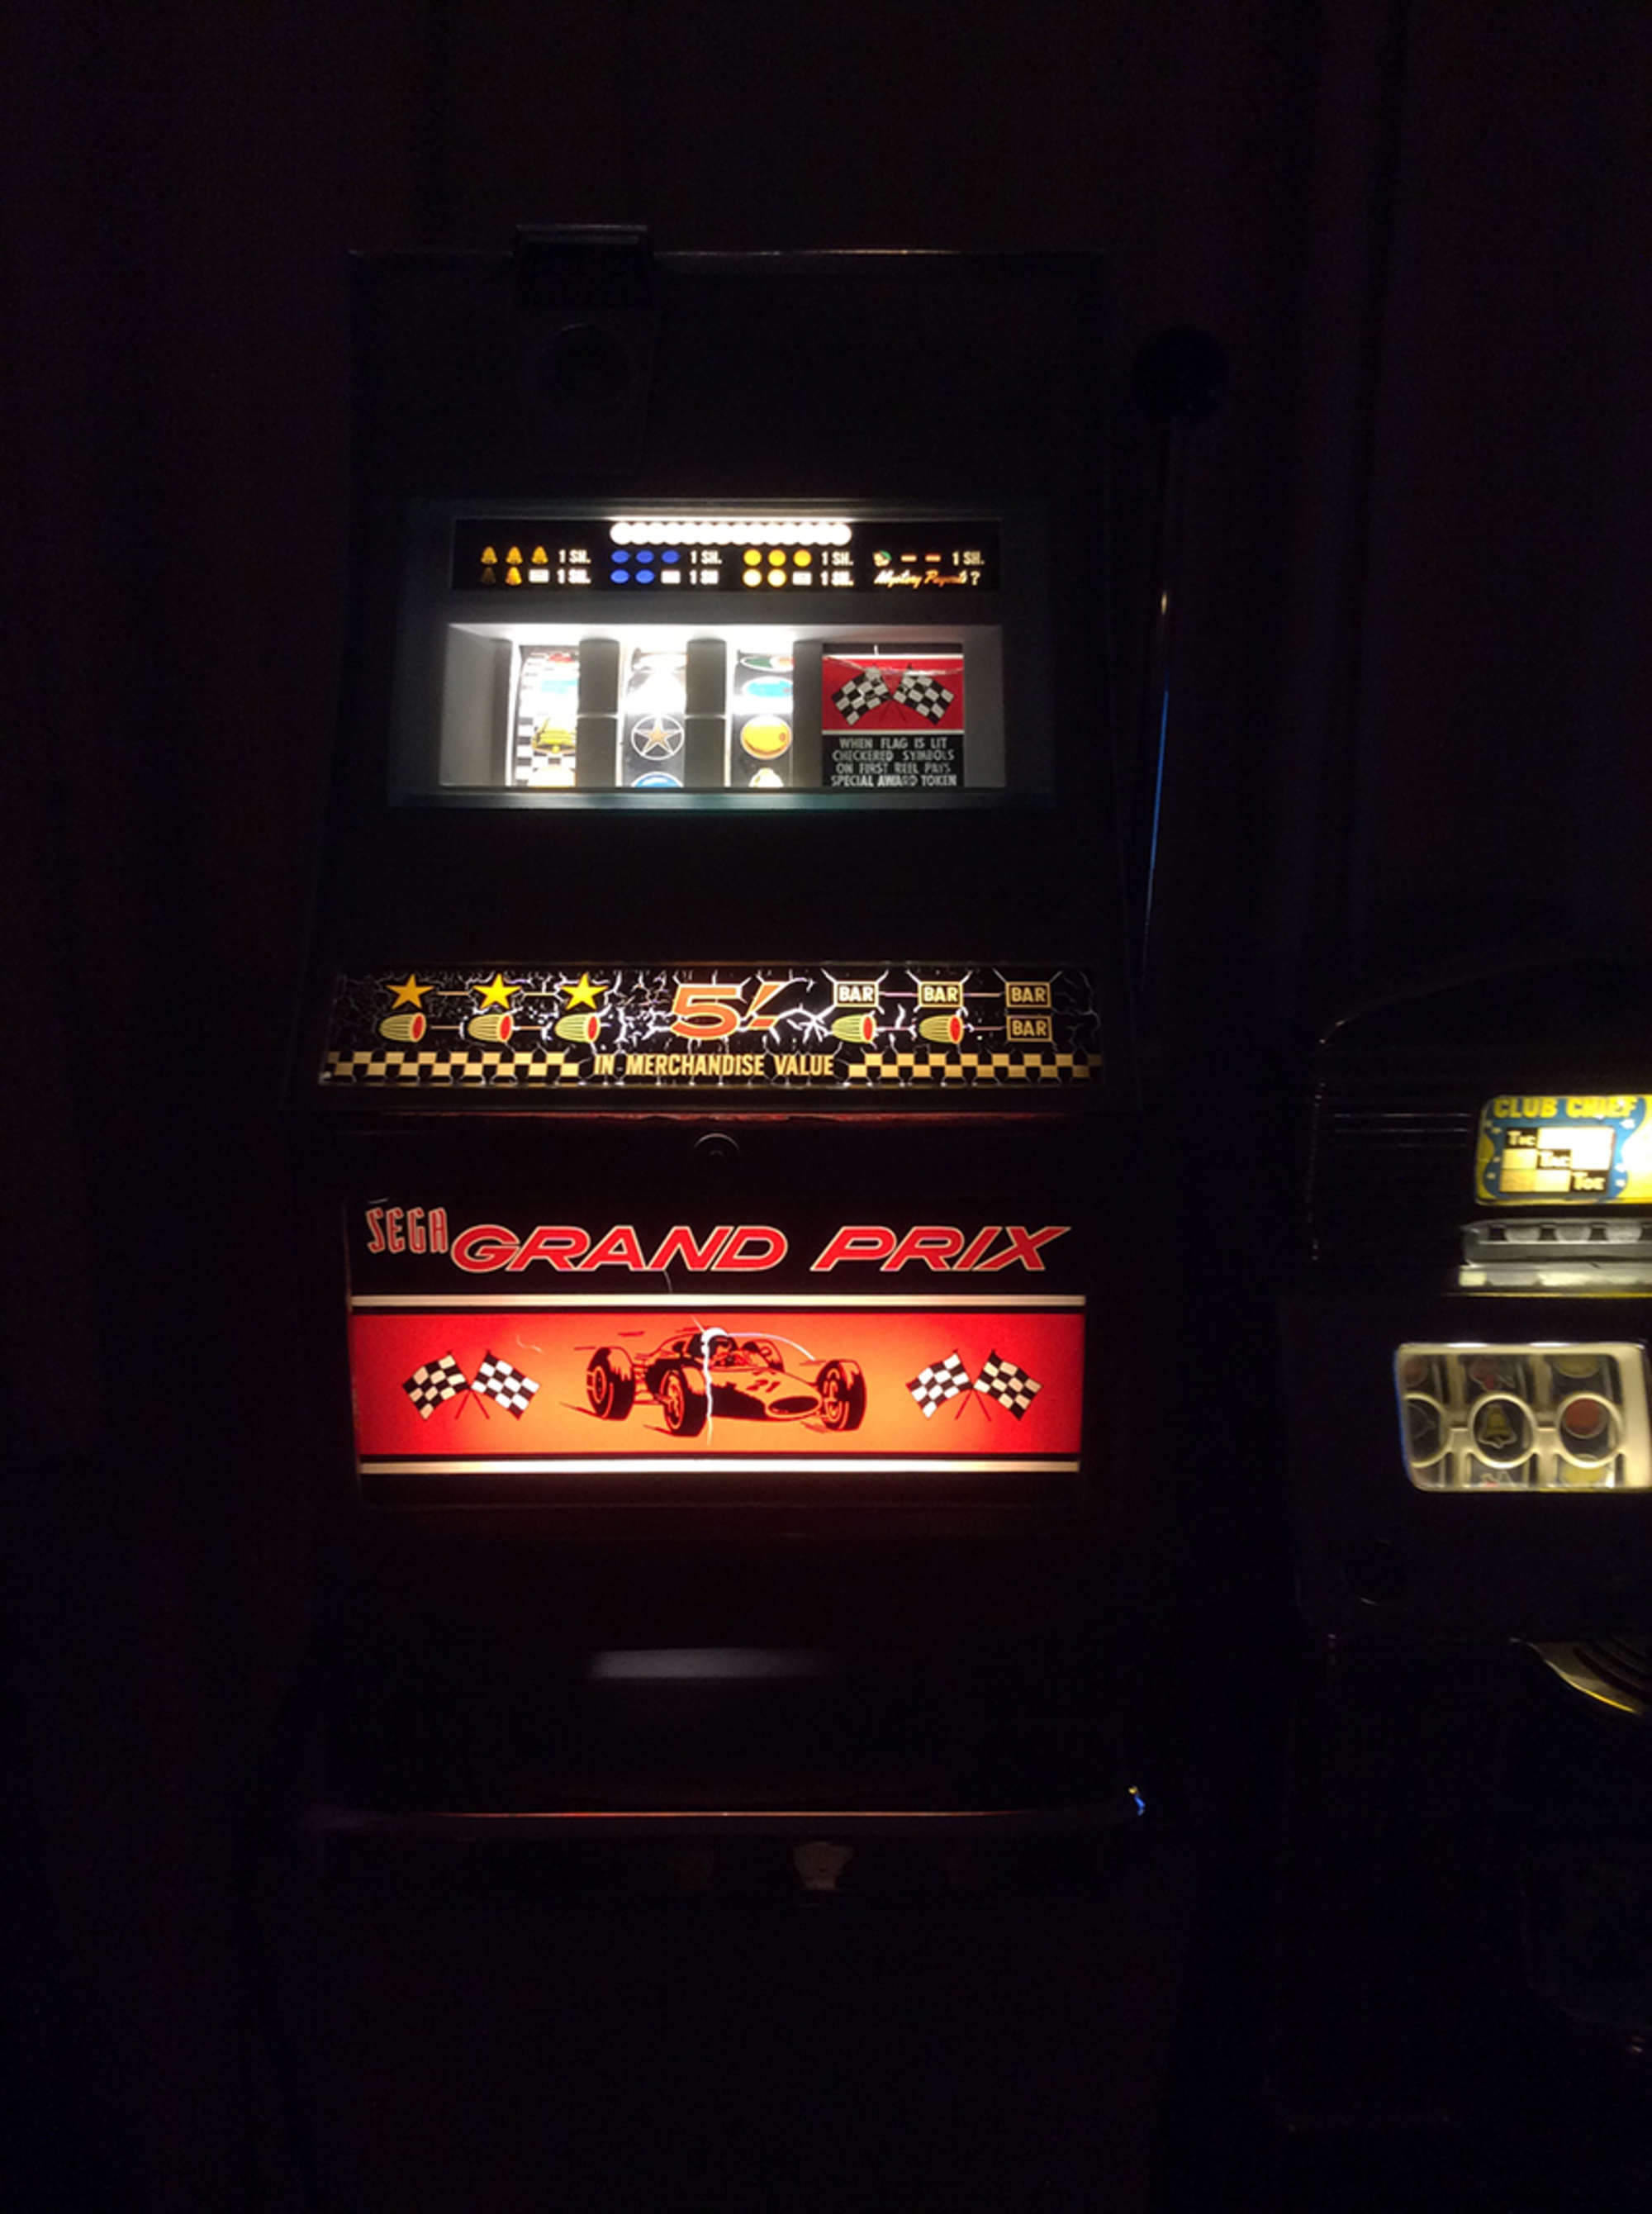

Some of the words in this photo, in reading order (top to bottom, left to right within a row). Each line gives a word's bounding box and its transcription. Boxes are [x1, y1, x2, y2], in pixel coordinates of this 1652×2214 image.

[558, 549, 566, 564] 1
[691, 550, 697, 564] 1
[821, 551, 828, 565] 1
[952, 551, 959, 565] 1
[558, 568, 565, 583] 1
[690, 570, 697, 583] 1
[820, 571, 828, 586] 1
[840, 738, 873, 748] WHEN
[881, 738, 908, 748] FLAG
[914, 738, 925, 748] IS
[931, 738, 947, 748] LIT
[832, 749, 894, 762] CHECKERED
[903, 750, 955, 761] SYMBOLS
[836, 763, 854, 774] ON
[859, 763, 889, 774] FIRST
[895, 763, 919, 774] REEL
[925, 763, 951, 774] PAYS
[831, 776, 874, 786] SPECIAL
[877, 776, 919, 786] AWARD
[922, 776, 957, 786] TOKEN
[838, 986, 874, 1003] BAR
[923, 986, 958, 1003] BAR
[1010, 986, 1046, 1002] BAR
[1011, 1020, 1047, 1036] BAR
[593, 1054, 615, 1075] IN
[625, 1054, 765, 1076] MERCHANDISE
[773, 1054, 834, 1076] VALUE
[1493, 1098, 1558, 1119] CLUB
[366, 1207, 448, 1254] SEGA
[450, 1224, 789, 1273] GRAND
[809, 1226, 1072, 1272] PRIX
